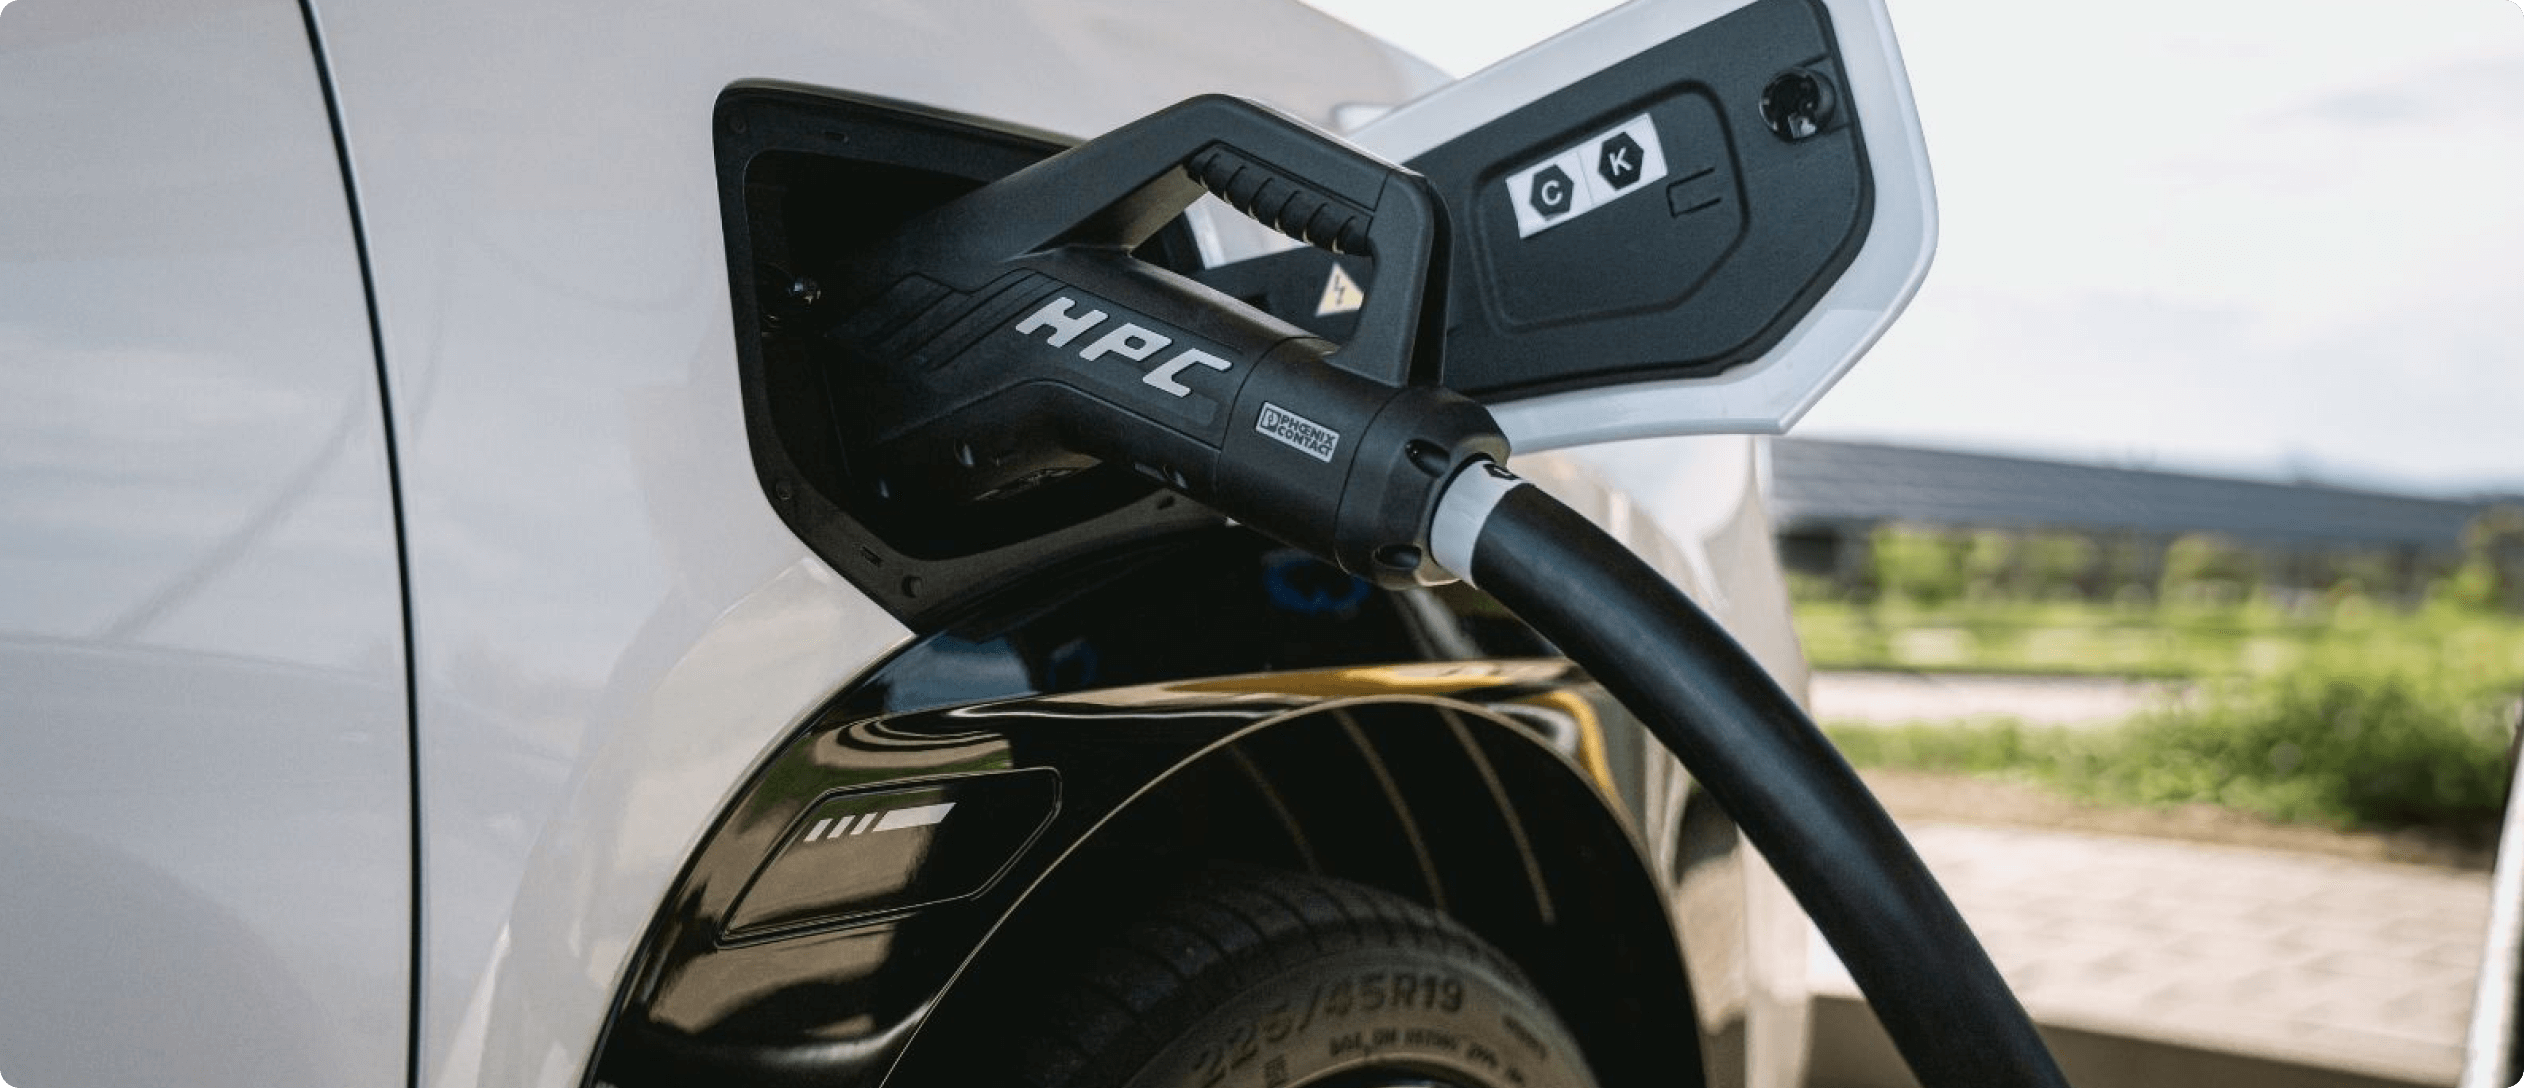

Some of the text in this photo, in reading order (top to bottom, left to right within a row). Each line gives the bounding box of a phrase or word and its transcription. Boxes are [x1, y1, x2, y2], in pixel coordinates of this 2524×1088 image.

[1541, 147, 1633, 205] C K
[1015, 296, 1233, 398] HPC
[1278, 426, 1333, 457] CONTACT
